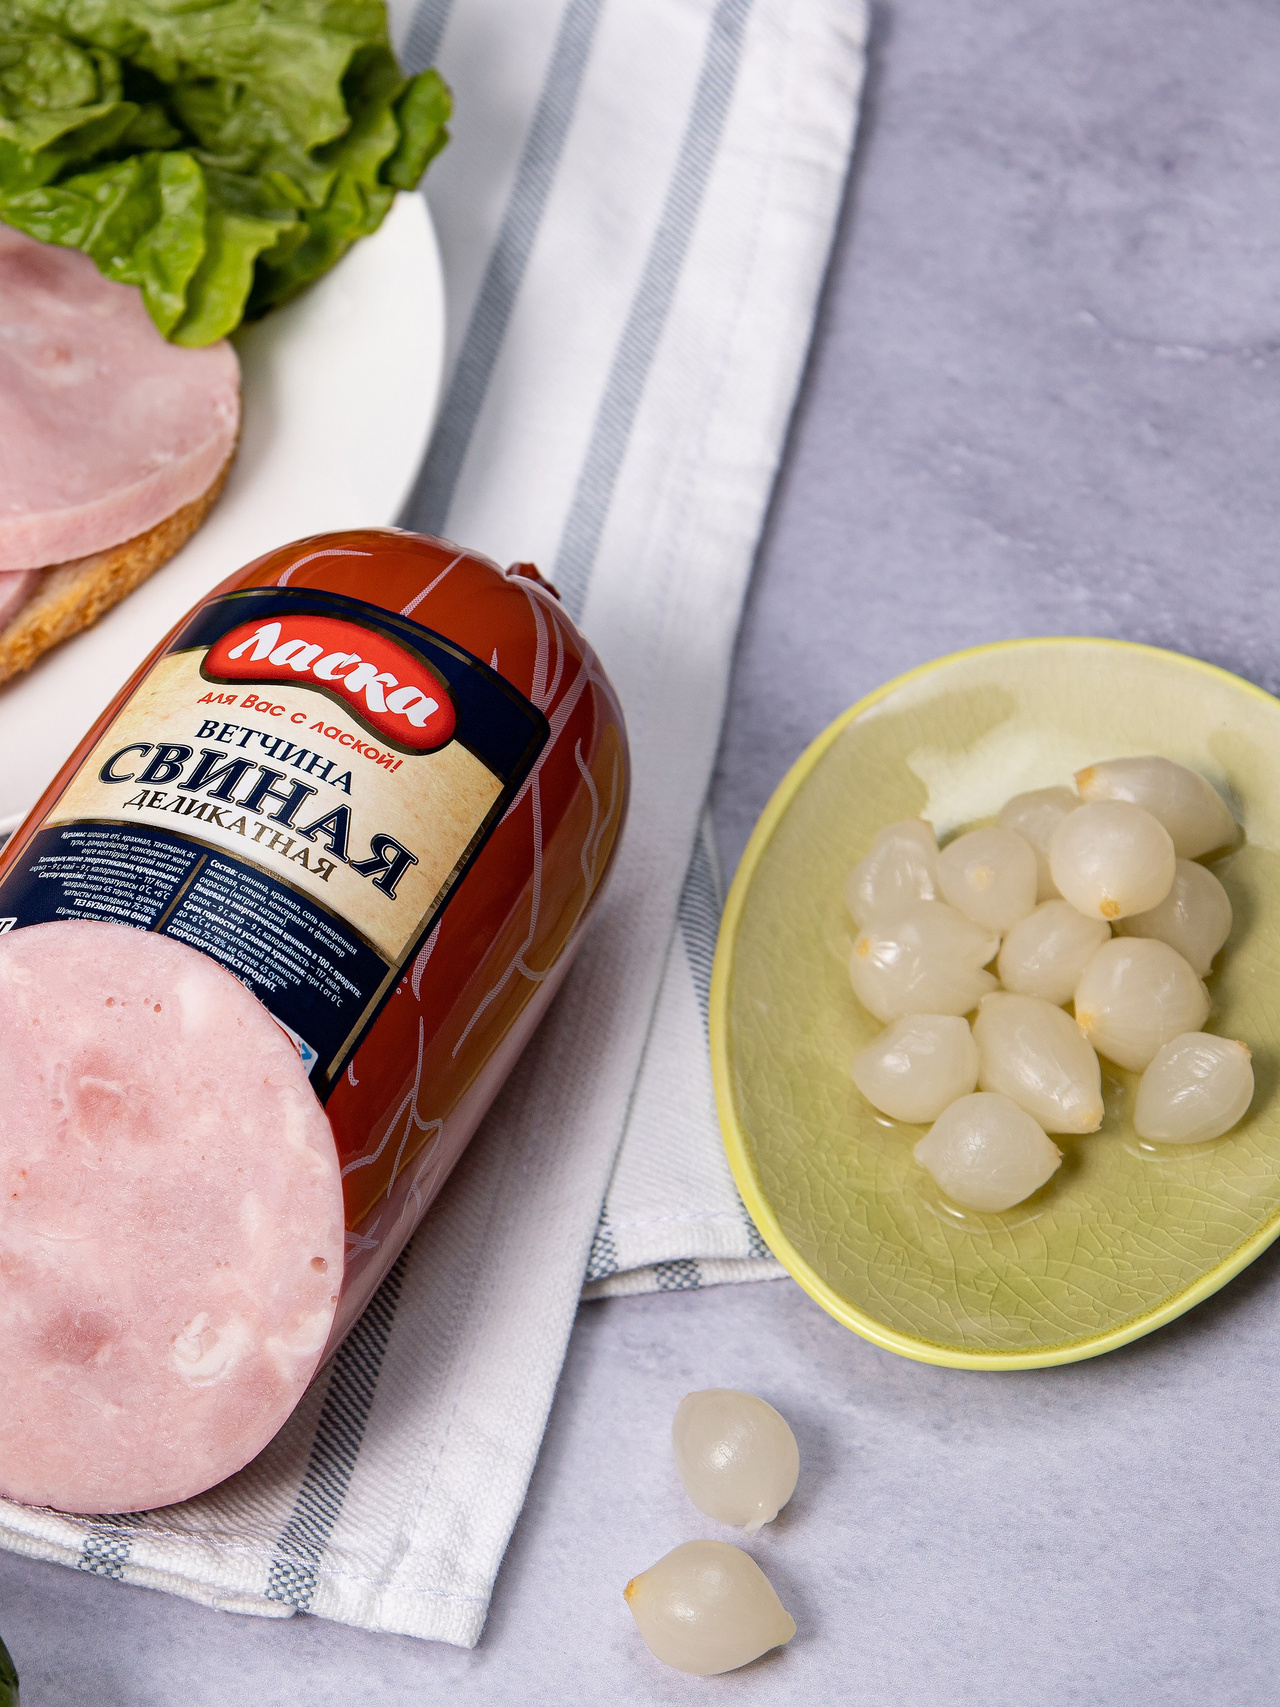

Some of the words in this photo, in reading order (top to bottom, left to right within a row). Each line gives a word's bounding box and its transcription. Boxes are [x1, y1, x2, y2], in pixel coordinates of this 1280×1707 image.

[228, 622, 439, 727] Ласка
[195, 719, 353, 795] ВЕТЧИНА
[197, 692, 238, 705] для
[240, 694, 286, 716] Вас
[290, 712, 307, 724] с
[309, 721, 403, 774] лаской!
[98, 742, 419, 901] СВИНАЯ
[121, 835, 151, 846] крахмал,
[186, 851, 197, 859] ас
[123, 789, 338, 882] ДЕЛИКАТНАЯ
[130, 845, 172, 860] консервант
[86, 874, 138, 890] температурасы
[129, 854, 156, 866] натрий
[143, 876, 155, 884] 117
[73, 898, 87, 906] ТЕЗ
[131, 901, 157, 916] 75-78%.
[199, 876, 230, 895] окраски
[229, 886, 260, 909] (нитрит
[258, 905, 290, 928] натрия).
[204, 868, 238, 887] пищевая,
[239, 884, 267, 905] специи,
[268, 900, 309, 929] консервант
[313, 930, 345, 958] фиксатор
[210, 859, 239, 877] Состав:
[238, 872, 269, 894] свинина,
[270, 890, 301, 915] крахмал,
[302, 910, 318, 925] соль
[318, 921, 358, 955] поваренная
[167, 925, 244, 969] СКОРОПОРТЯЩИЙСЯ
[242, 964, 277, 993] ПРОДУКТ.
[172, 918, 202, 936] воздуха
[201, 930, 227, 948] 75-78%
[226, 944, 237, 954] не
[236, 949, 260, 968] более
[259, 963, 270, 974] 45
[267, 970, 288, 990] суток.
[176, 909, 188, 918] до
[211, 925, 265, 960] относительной
[264, 956, 302, 986] влажности
[183, 900, 204, 914] Срок
[202, 909, 237, 931] годности
[240, 930, 272, 951] условия
[271, 949, 307, 977] хранения:
[305, 974, 320, 988] при
[323, 988, 332, 997] от
[188, 892, 212, 908] белок
[228, 912, 245, 924] жир
[262, 931, 310, 967] калорийность
[315, 967, 327, 978] 117
[325, 977, 340, 994] ккал.
[193, 882, 226, 903] Пищевая
[230, 901, 284, 936] энергетическая
[282, 931, 313, 957] ценность
[317, 956, 330, 969] 100
[333, 970, 362, 999] продукта:
